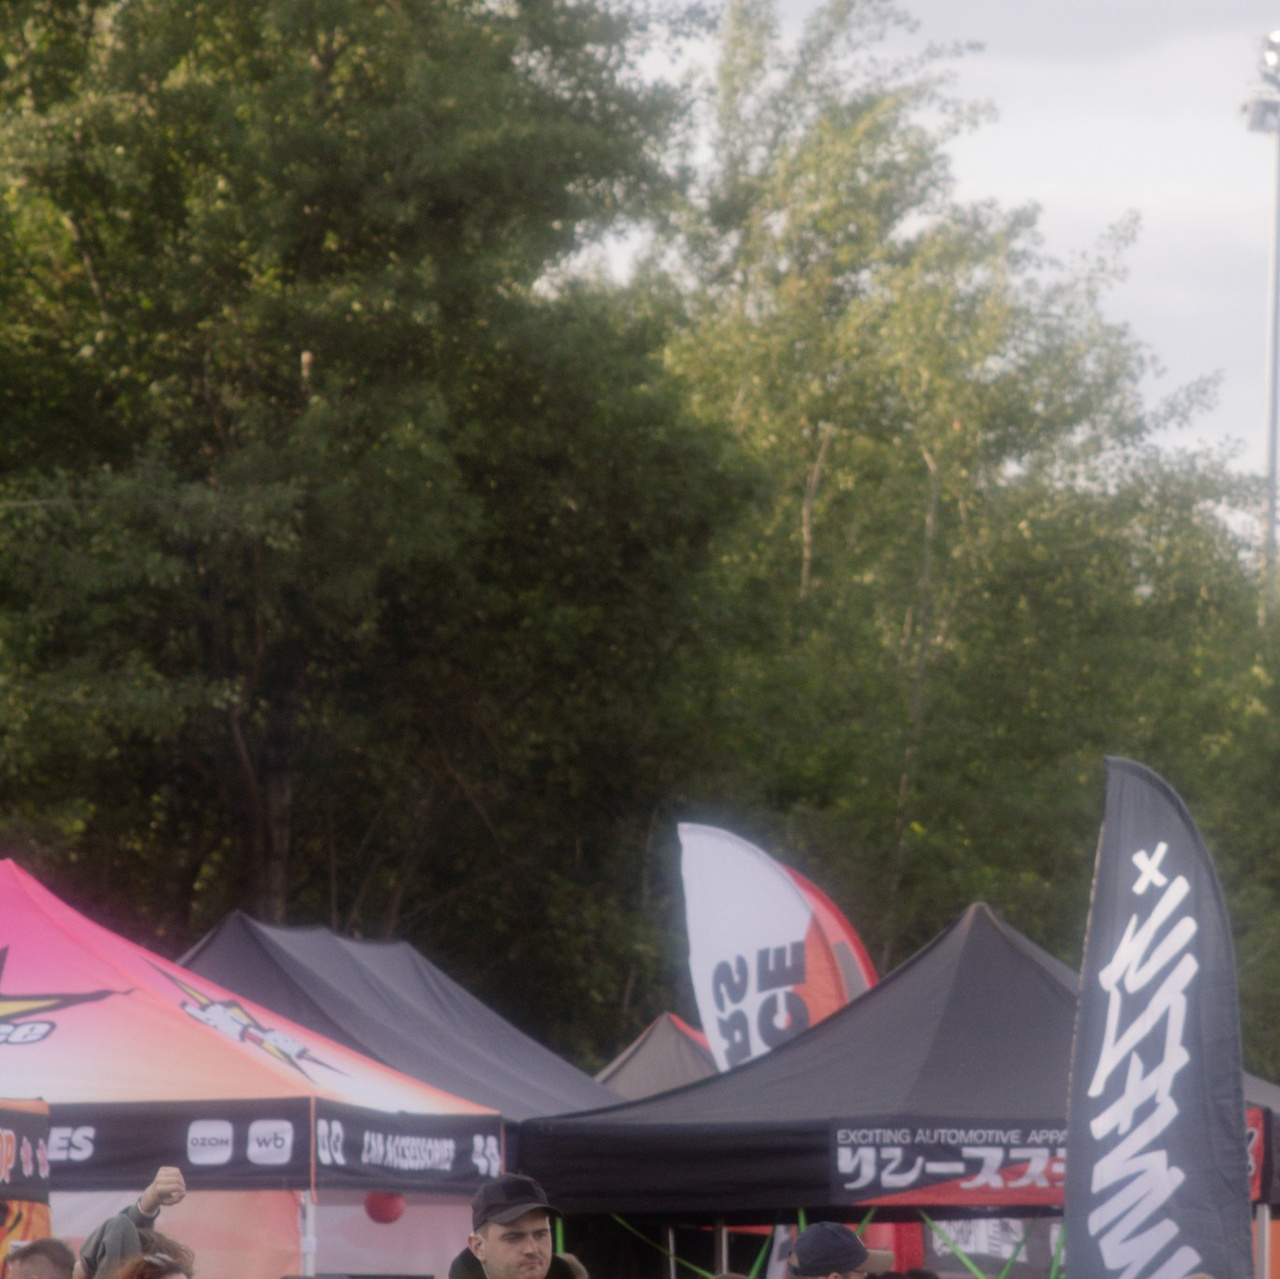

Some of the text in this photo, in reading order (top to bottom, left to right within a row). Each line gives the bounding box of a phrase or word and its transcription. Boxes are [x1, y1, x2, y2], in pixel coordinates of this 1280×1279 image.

[190, 1137, 230, 1147] OZON
[837, 1128, 911, 1145] EXCITING
[914, 1128, 1021, 1145] AUTOMOTIVE
